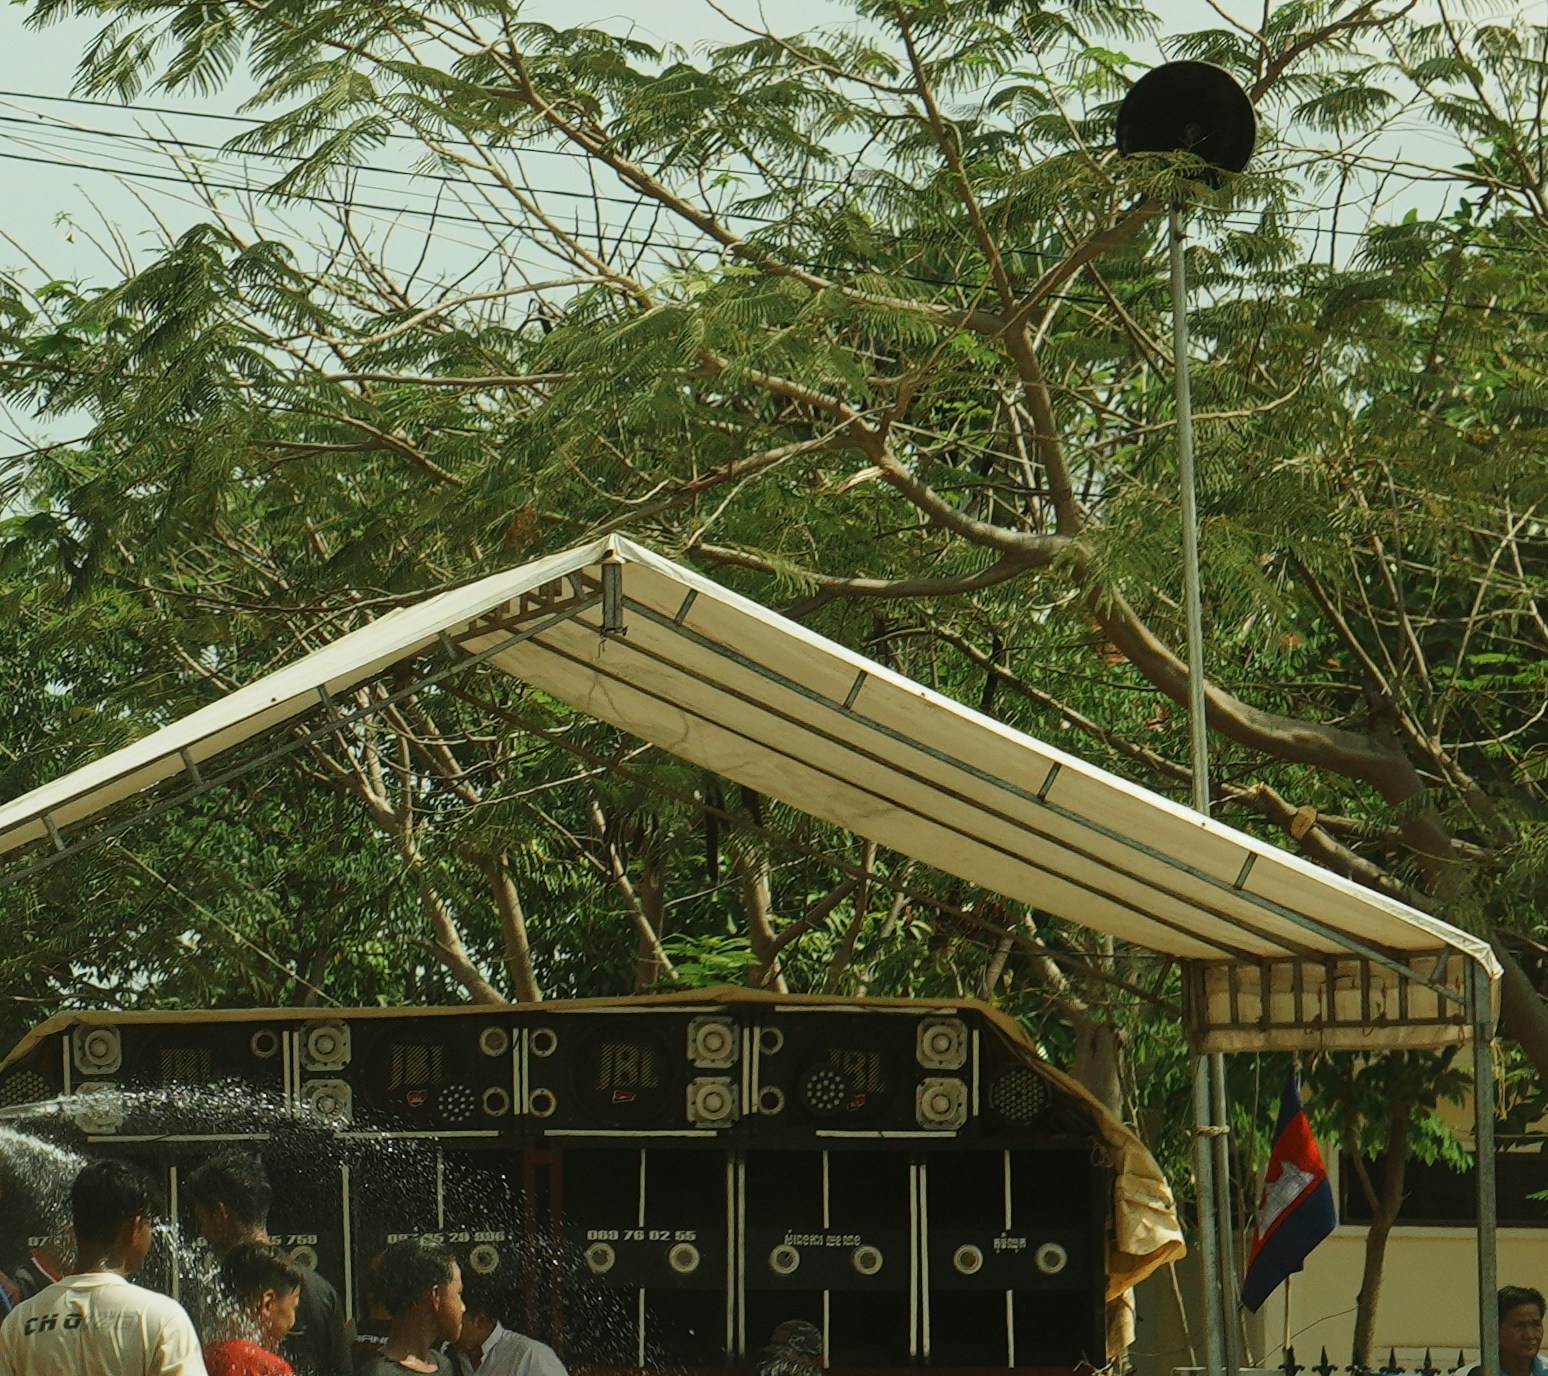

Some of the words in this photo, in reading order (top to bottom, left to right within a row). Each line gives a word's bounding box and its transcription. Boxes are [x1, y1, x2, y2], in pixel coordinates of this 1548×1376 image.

[596, 1041, 660, 1092] JBL
[648, 1229, 671, 1241] 02
[674, 1230, 697, 1242] 55
